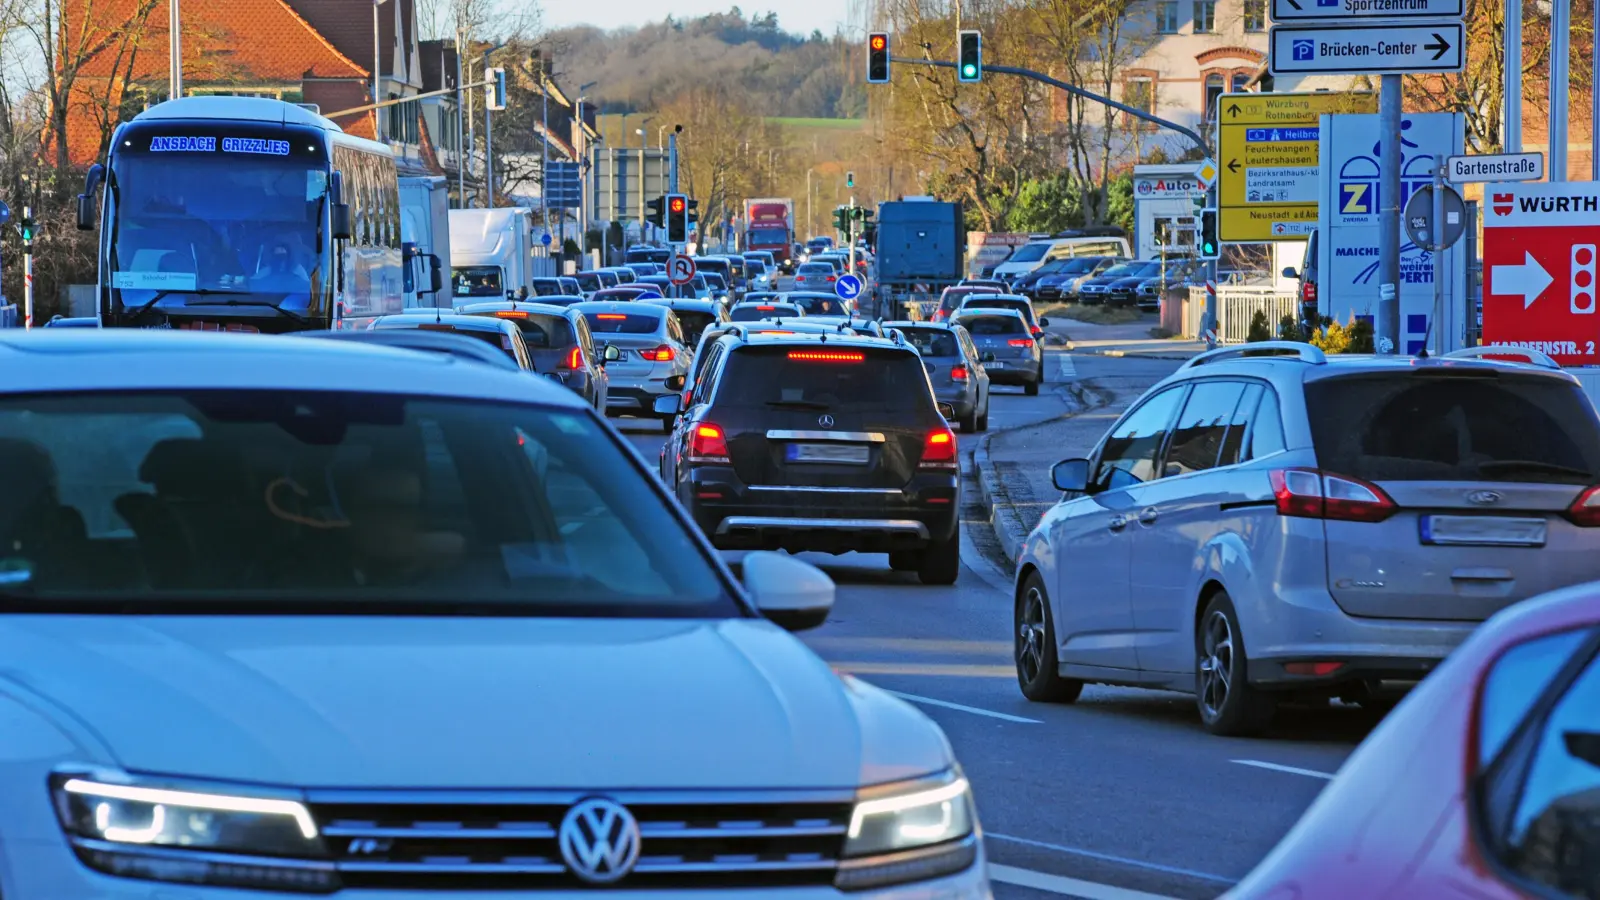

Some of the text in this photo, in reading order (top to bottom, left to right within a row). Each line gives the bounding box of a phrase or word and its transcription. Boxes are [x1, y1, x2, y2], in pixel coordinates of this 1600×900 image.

[1344, 0, 1428, 14] Sportzentrum
[1320, 40, 1417, 57] Brücken-Center
[1265, 99, 1309, 110] Würzburg
[1265, 110, 1317, 121] Rothenburg
[149, 136, 290, 156] ANSBACH GRIZZLIES
[1245, 144, 1310, 155] Feuchtwangen
[1245, 155, 1311, 165] Leutershausen
[1456, 158, 1536, 176] Gartenstraße
[1247, 179, 1296, 188] Landratsamt
[1341, 183, 1369, 213] Z
[1519, 195, 1598, 213] WÜRTH
[1249, 211, 1290, 220] Neustadt
[1335, 247, 1380, 257] MAICHE
[1585, 340, 1596, 356] 2
